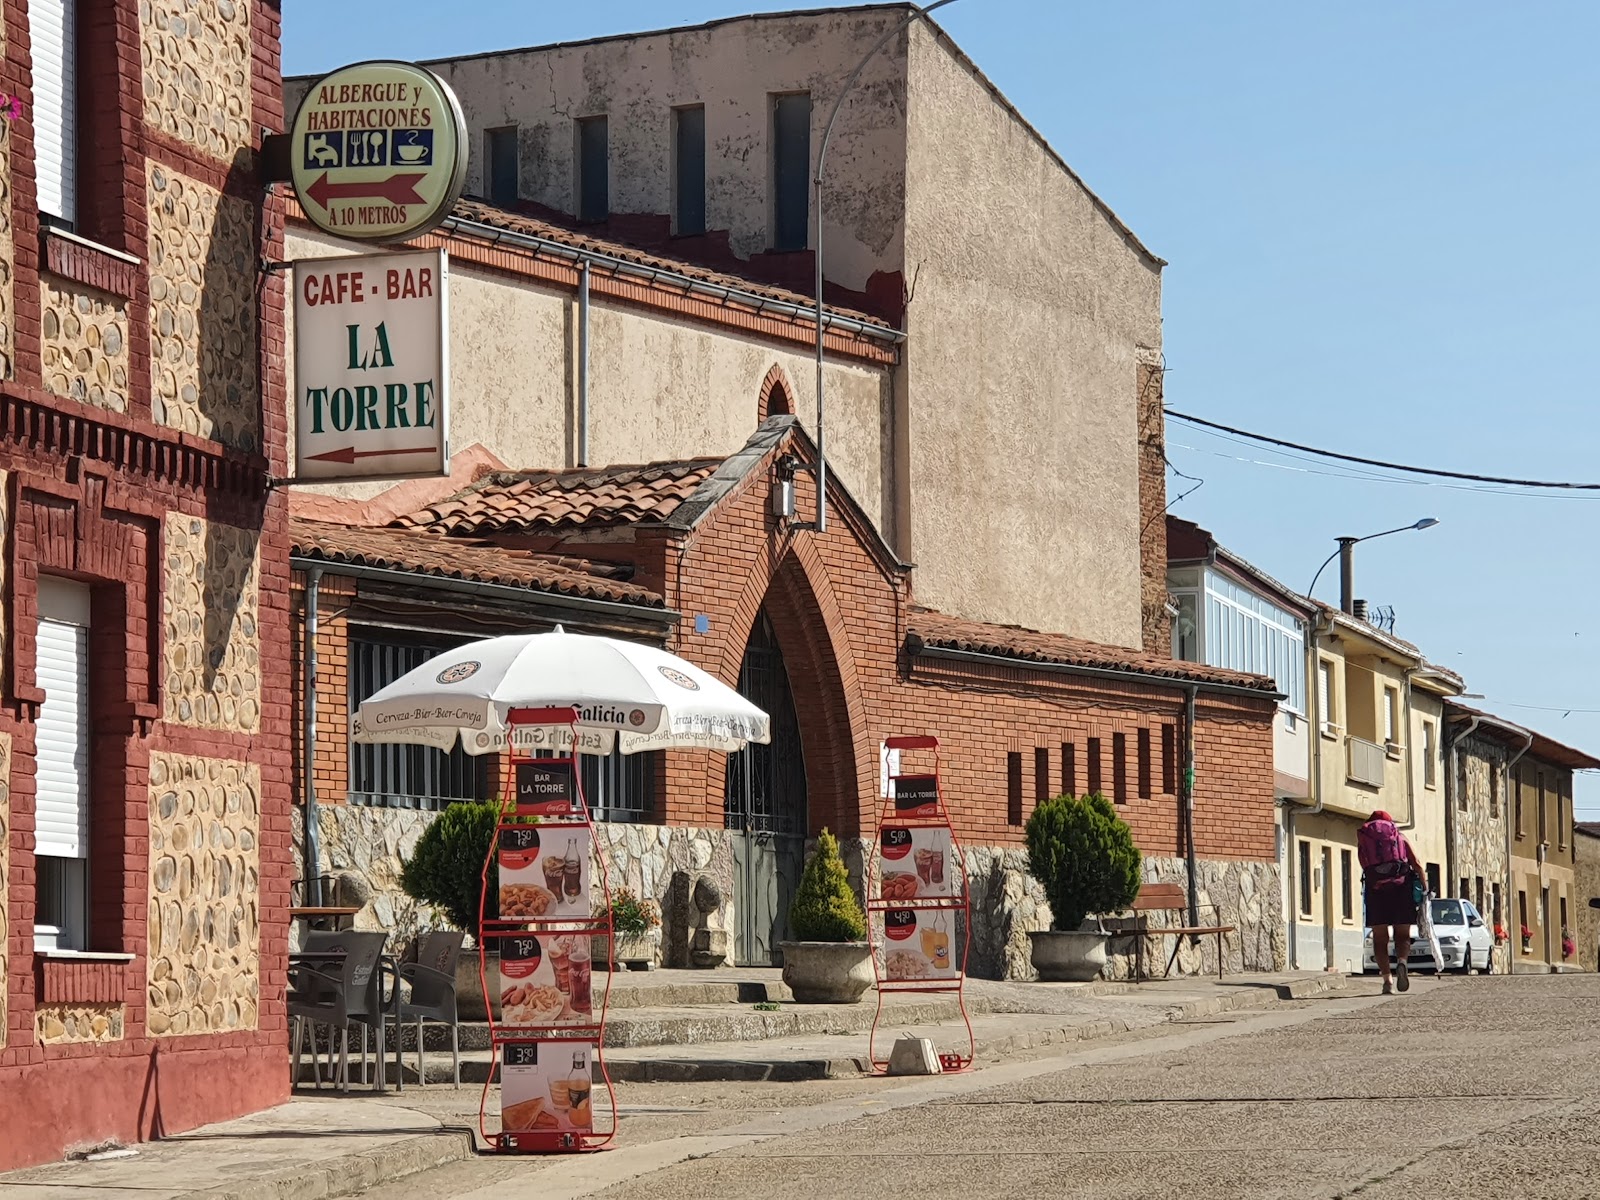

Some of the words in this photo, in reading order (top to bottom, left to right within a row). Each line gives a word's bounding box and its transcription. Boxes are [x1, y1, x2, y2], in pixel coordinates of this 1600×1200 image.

[317, 83, 407, 104] ALBERGUE
[413, 86, 422, 106] y
[307, 108, 431, 131] HABITACIONES
[329, 208, 337, 226] A
[341, 207, 355, 225] 10
[358, 206, 407, 224] METROS
[304, 272, 364, 306] CAFE
[387, 268, 432, 300] BAR
[346, 321, 394, 372] LA
[306, 378, 436, 434] TORRE
[521, 785, 533, 793] LA
[535, 784, 564, 793] TORRE
[534, 774, 550, 782] BAR
